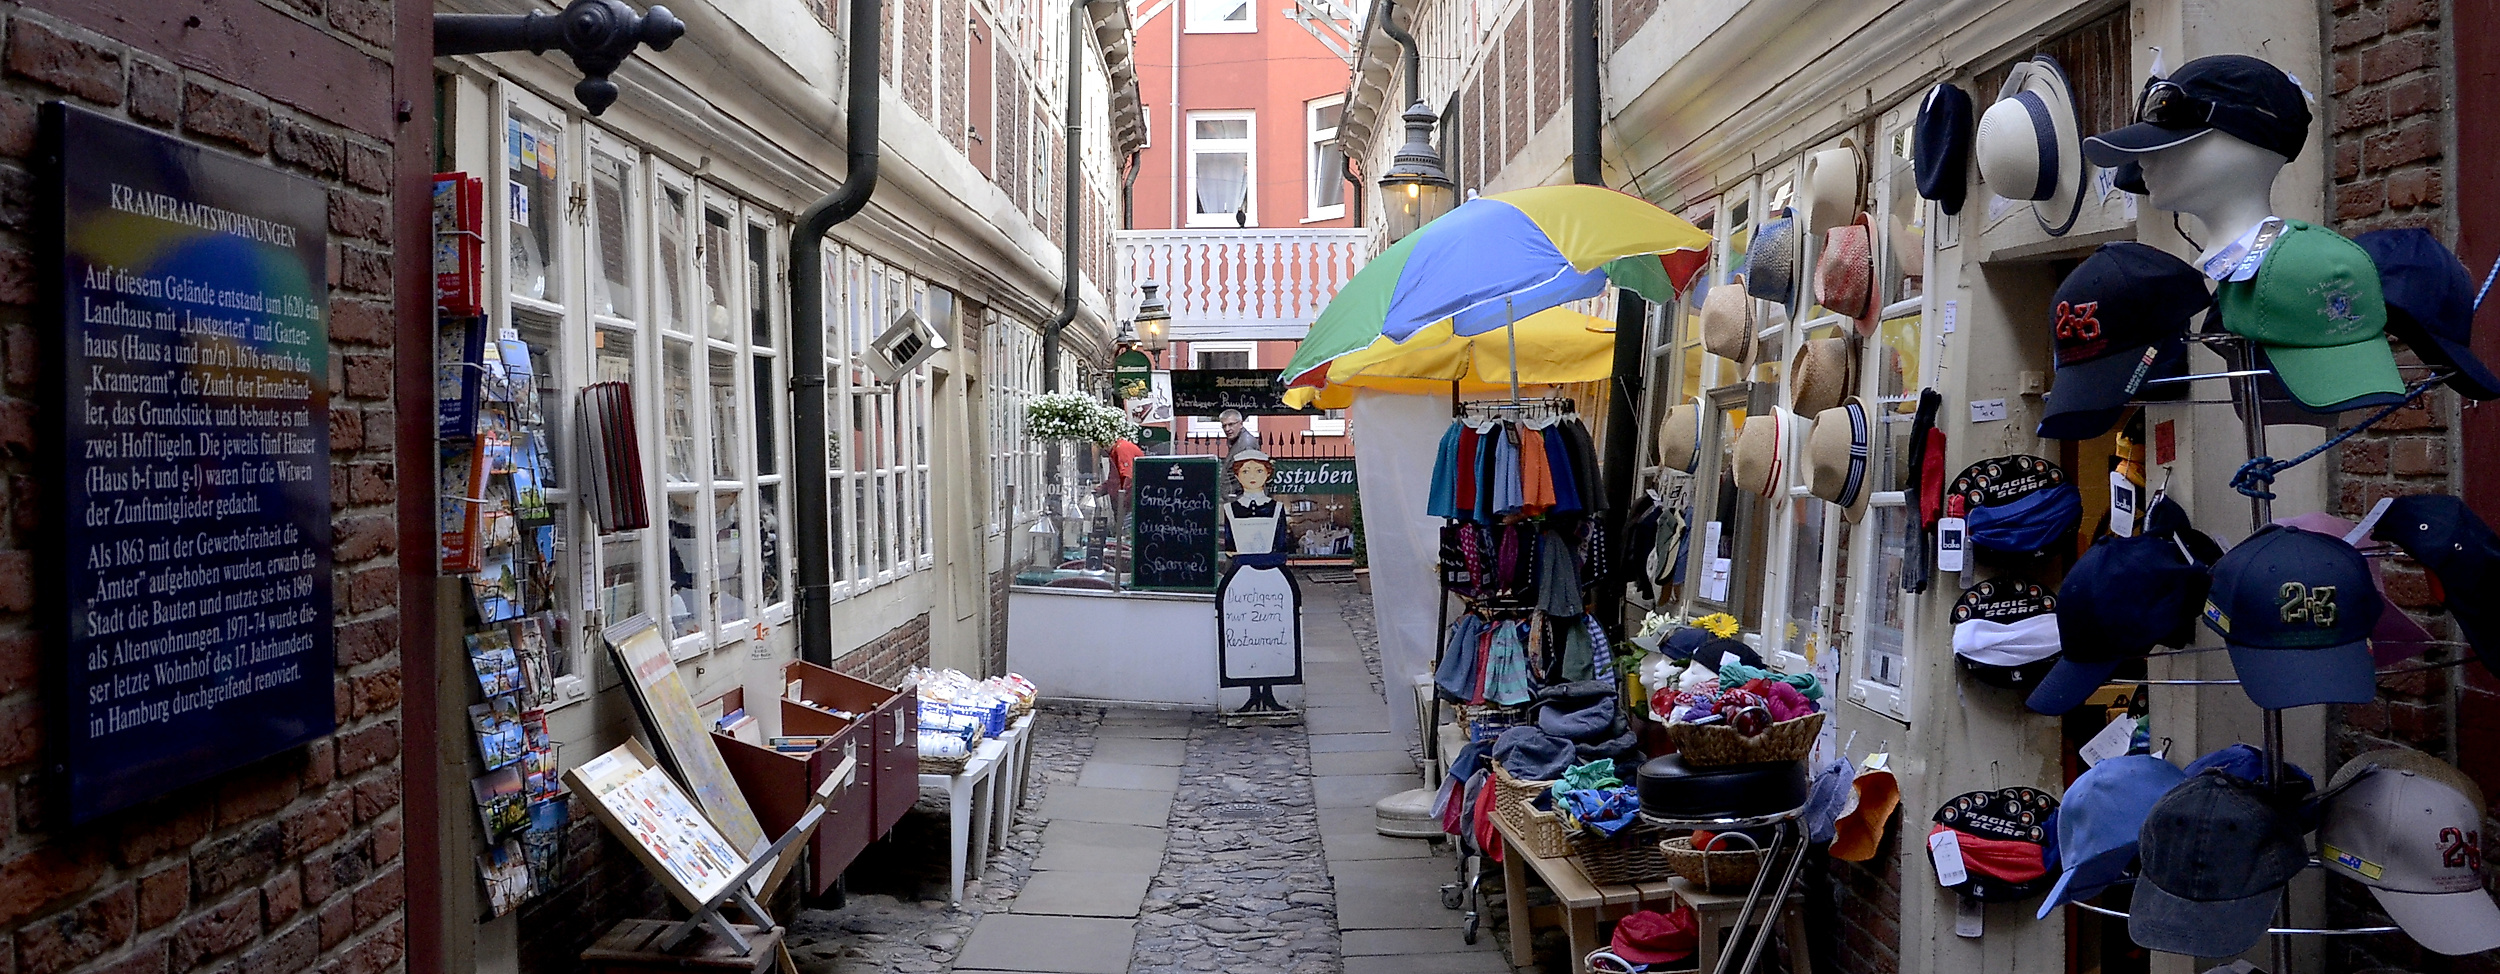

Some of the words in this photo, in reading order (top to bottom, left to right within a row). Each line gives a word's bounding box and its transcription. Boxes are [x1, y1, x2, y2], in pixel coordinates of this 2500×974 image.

[111, 182, 296, 248] KRAMERAMTSWOHNUNGEN
[83, 263, 114, 291] Auf
[115, 268, 162, 298] diesem
[165, 275, 216, 306] Gelände
[218, 290, 263, 312] entstand
[265, 297, 282, 315] um
[283, 294, 304, 318] 1620
[305, 298, 320, 321] ein
[83, 296, 152, 329] Landhaus
[155, 306, 177, 332] mit
[253, 320, 273, 342] und
[274, 321, 311, 346] Garten-
[84, 330, 118, 359] haus
[121, 334, 161, 364] (Haus
[163, 344, 172, 363] a
[174, 341, 199, 365] und
[201, 342, 233, 371] m/n).
[236, 345, 259, 369] 1676
[260, 350, 293, 372] erwarb
[295, 351, 311, 373] das
[180, 370, 199, 396] die
[202, 372, 234, 397] Zunft
[236, 375, 255, 398] der
[256, 375, 313, 400] Einzelhänd-
[1215, 376, 1270, 388] Restaurant
[84, 398, 109, 429] ler,
[112, 400, 136, 425] das
[139, 400, 213, 426] Grundstück
[215, 403, 237, 426] und
[239, 404, 280, 427] bebaute
[281, 411, 292, 427] es
[293, 405, 310, 427] mit
[85, 432, 117, 459] zwei
[199, 432, 220, 457] Die
[221, 432, 259, 461] jeweils
[260, 431, 283, 455] fünf
[283, 432, 316, 454] Häuser
[85, 465, 128, 497] (Haus
[131, 463, 153, 491] b-f
[154, 464, 179, 490] und
[182, 463, 203, 493] g-l)
[205, 468, 239, 486] waren
[241, 461, 258, 485] für
[259, 461, 275, 484] die
[276, 460, 312, 482] Witwen
[1281, 484, 1305, 493] 1718
[1989, 474, 2036, 493] MAGIC
[1997, 479, 2048, 499] SCARF
[85, 501, 111, 527] der
[114, 494, 214, 525] Zunftmitglieder
[216, 491, 261, 521] gedacht.
[87, 542, 112, 569] Als
[115, 538, 144, 566] 1863
[148, 536, 170, 562] mit
[173, 535, 194, 559] der
[196, 524, 282, 556] Gewerbefreiheit
[283, 522, 299, 545] die
[149, 563, 220, 596] aufgehoben
[223, 557, 266, 581] wurden,
[267, 550, 300, 575] erwarb
[301, 547, 316, 570] die
[87, 607, 124, 638] Stadt
[128, 603, 149, 630] die
[152, 600, 196, 626] Bauten
[199, 596, 222, 617] und
[225, 589, 258, 612] nutzte
[260, 582, 275, 605] sie
[276, 579, 291, 602] bis
[292, 573, 313, 598] 1969
[1228, 587, 1284, 609] Durchgang
[1977, 599, 2028, 611] MAGIC
[1984, 605, 2040, 618] SCARF
[1226, 612, 1247, 622] nur
[88, 643, 108, 671] als
[112, 626, 224, 666] Altenwohnungen.
[268, 605, 298, 630] wurde
[299, 602, 318, 624] die-
[1226, 627, 1288, 648] Restaurant
[89, 682, 111, 705] ser
[113, 672, 150, 699] letzte
[153, 650, 212, 686] Wohnhof
[213, 650, 233, 674] des
[235, 643, 248, 669] 17.
[249, 632, 314, 665] Jahrhunderts
[90, 712, 104, 739] in
[108, 699, 170, 734] Hamburg
[172, 671, 252, 715] durchgreifend
[254, 662, 302, 692] renoviert.
[1965, 811, 2018, 829] MAGIC
[1969, 820, 2026, 837] SCARF
